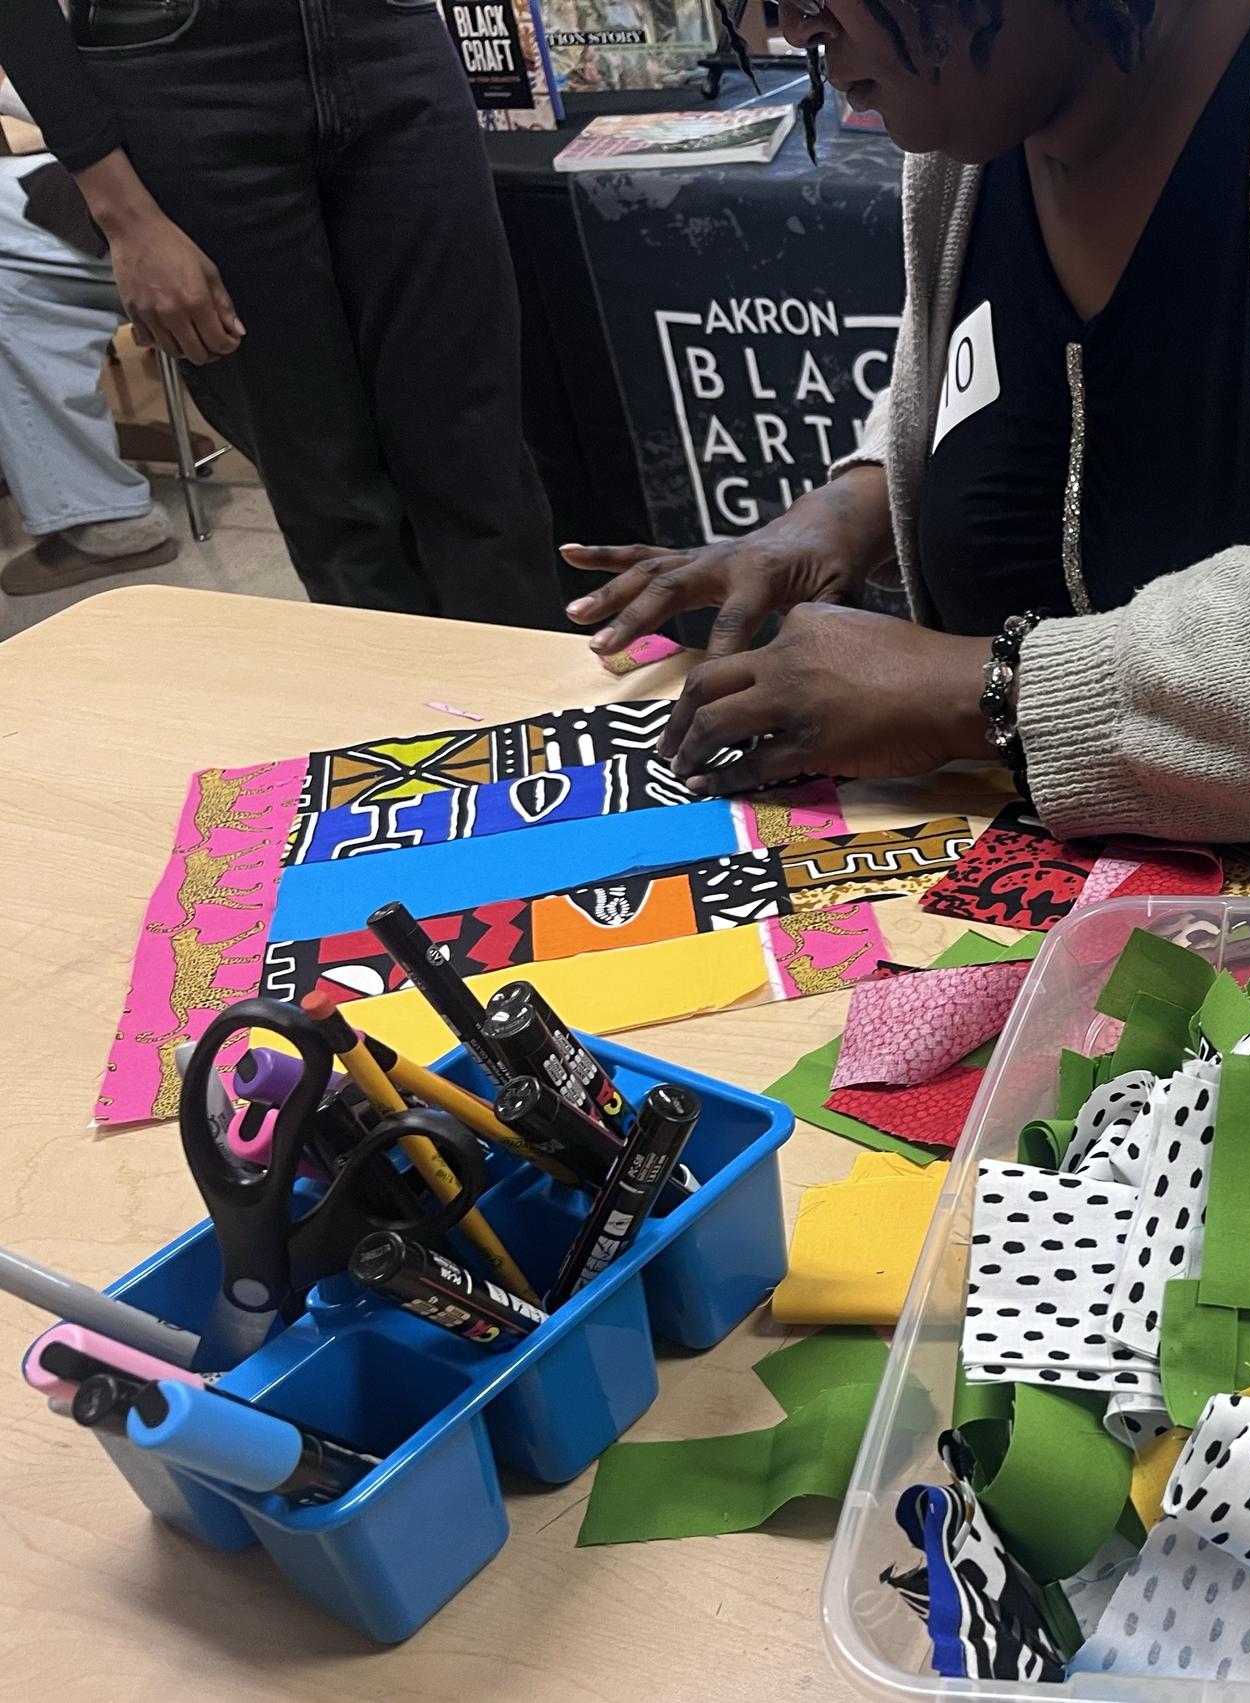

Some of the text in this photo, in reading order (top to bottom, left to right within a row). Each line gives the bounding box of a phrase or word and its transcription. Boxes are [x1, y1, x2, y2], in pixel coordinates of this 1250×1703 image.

[453, 5, 509, 38] BLACK
[461, 39, 515, 72] CRAFT
[705, 298, 840, 337] AKRON
[686, 346, 889, 403] BLAC
[703, 413, 867, 467] ARTI
